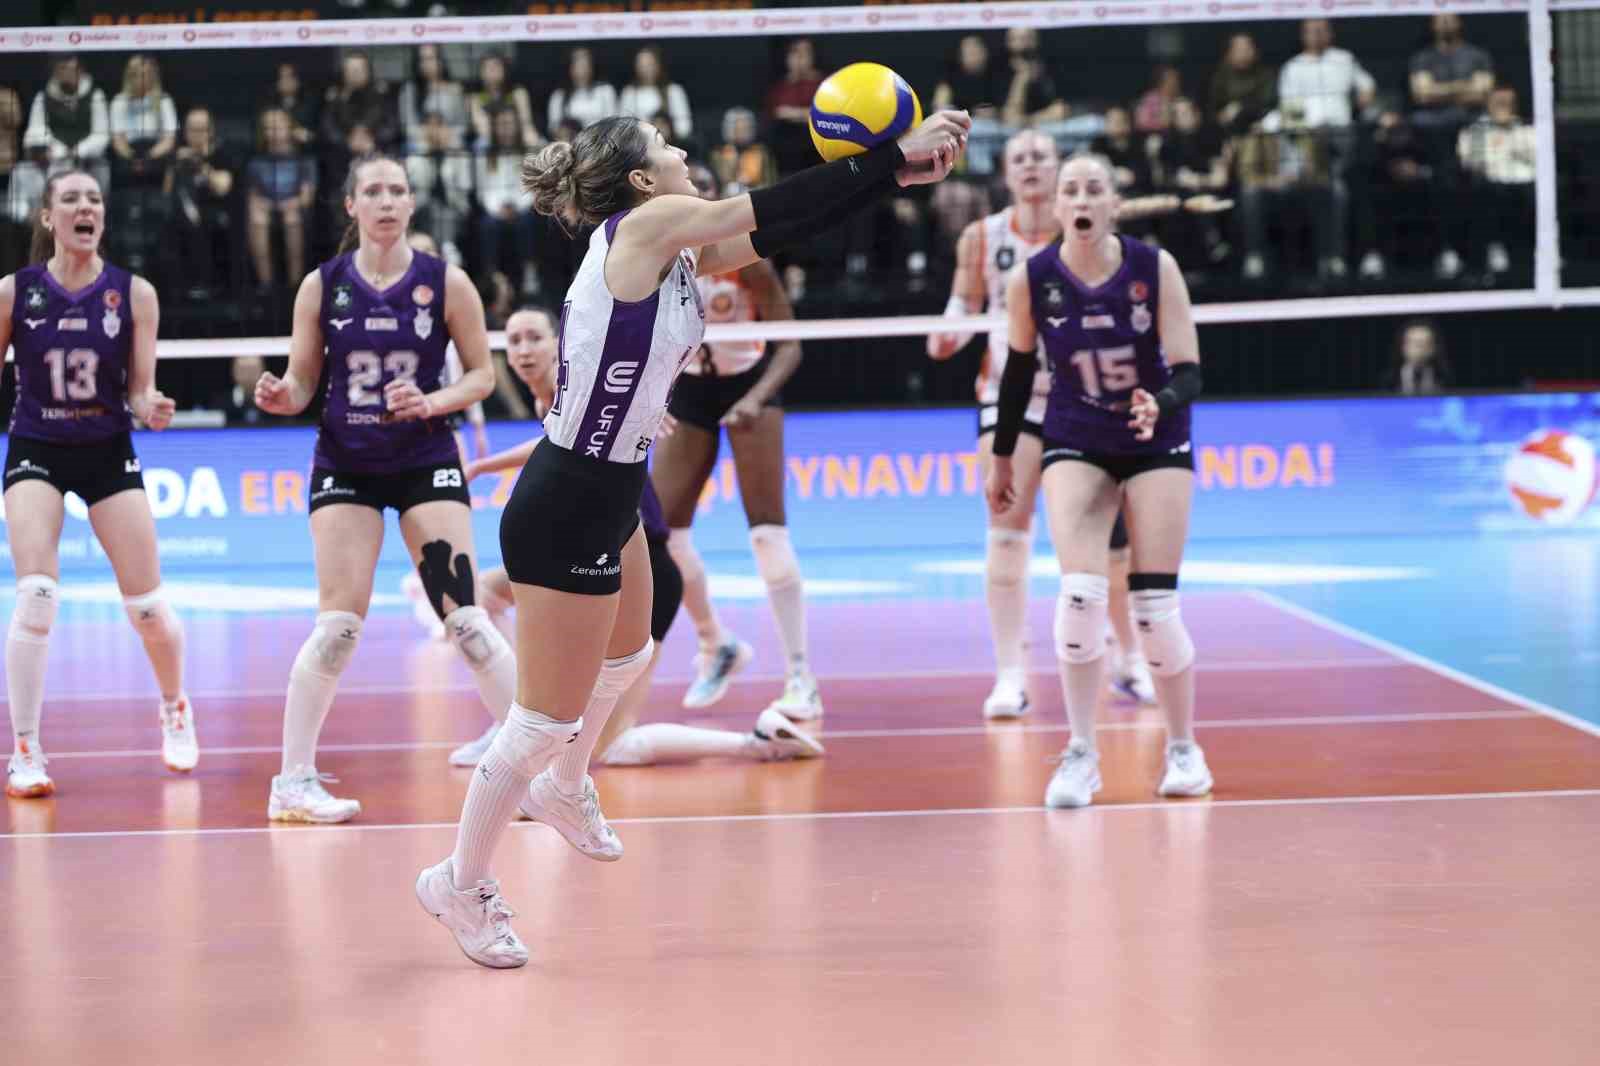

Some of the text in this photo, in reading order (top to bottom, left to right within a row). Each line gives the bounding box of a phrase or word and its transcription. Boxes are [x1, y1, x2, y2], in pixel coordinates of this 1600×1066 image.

[44, 348, 99, 402] 13
[1070, 345, 1139, 399] 15
[585, 404, 619, 459] UFUK
[433, 469, 462, 487] 23
[784, 452, 978, 498] YNAVIT
[570, 565, 602, 576] Zeren
